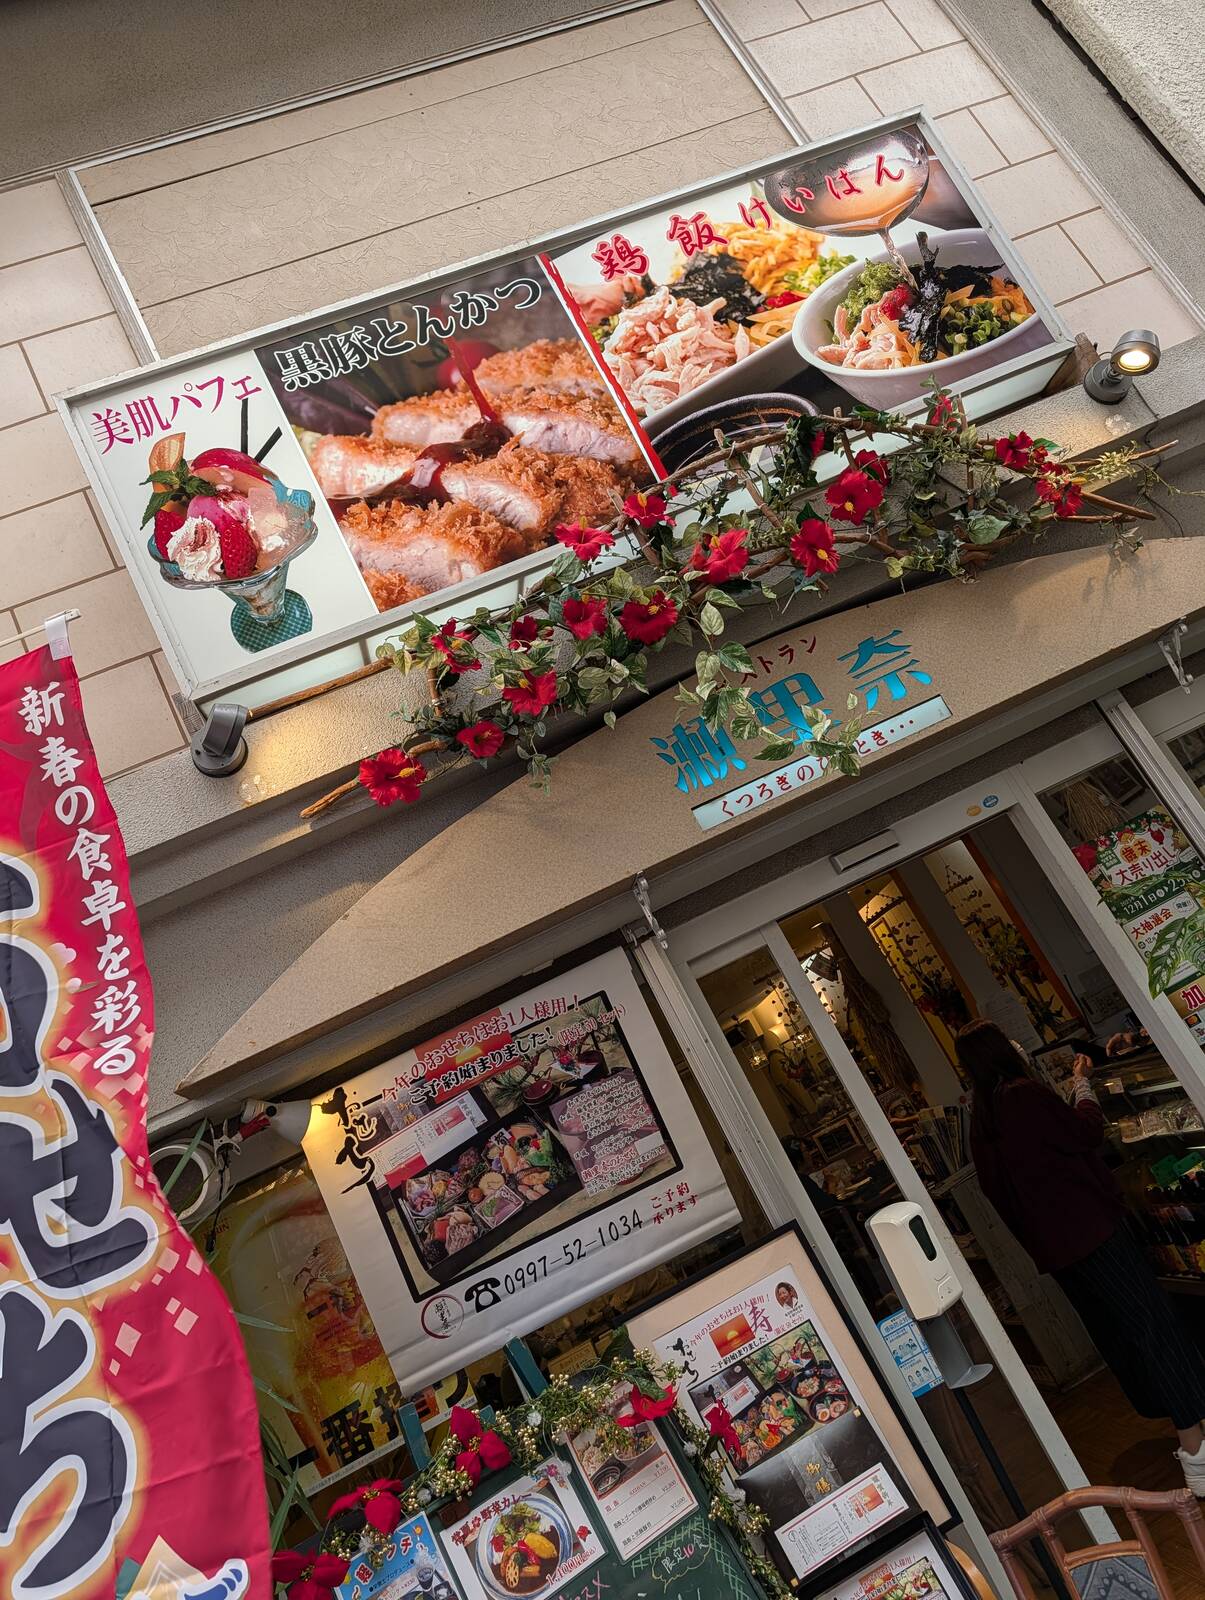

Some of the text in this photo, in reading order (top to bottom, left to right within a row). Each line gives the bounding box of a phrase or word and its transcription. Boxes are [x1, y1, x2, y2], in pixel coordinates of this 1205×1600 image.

[273, 277, 543, 391] 黒豚とんかつ
[90, 374, 263, 455] 美肌パフェ
[714, 635, 818, 692] ストラン
[649, 629, 933, 794] 瀬里奈
[1115, 849, 1176, 885] 大売り出し
[1121, 839, 1150, 864] 歳末
[18, 679, 142, 1077] 新春の食卓を彩る
[1131, 906, 1174, 941] 大抽選会
[650, 1181, 690, 1209] ご予約
[652, 1192, 700, 1225] 承ります
[503, 1208, 644, 1296] 0997-52-1034
[747, 1304, 774, 1336] 寿
[355, 1534, 414, 1586] 軽ンチ
